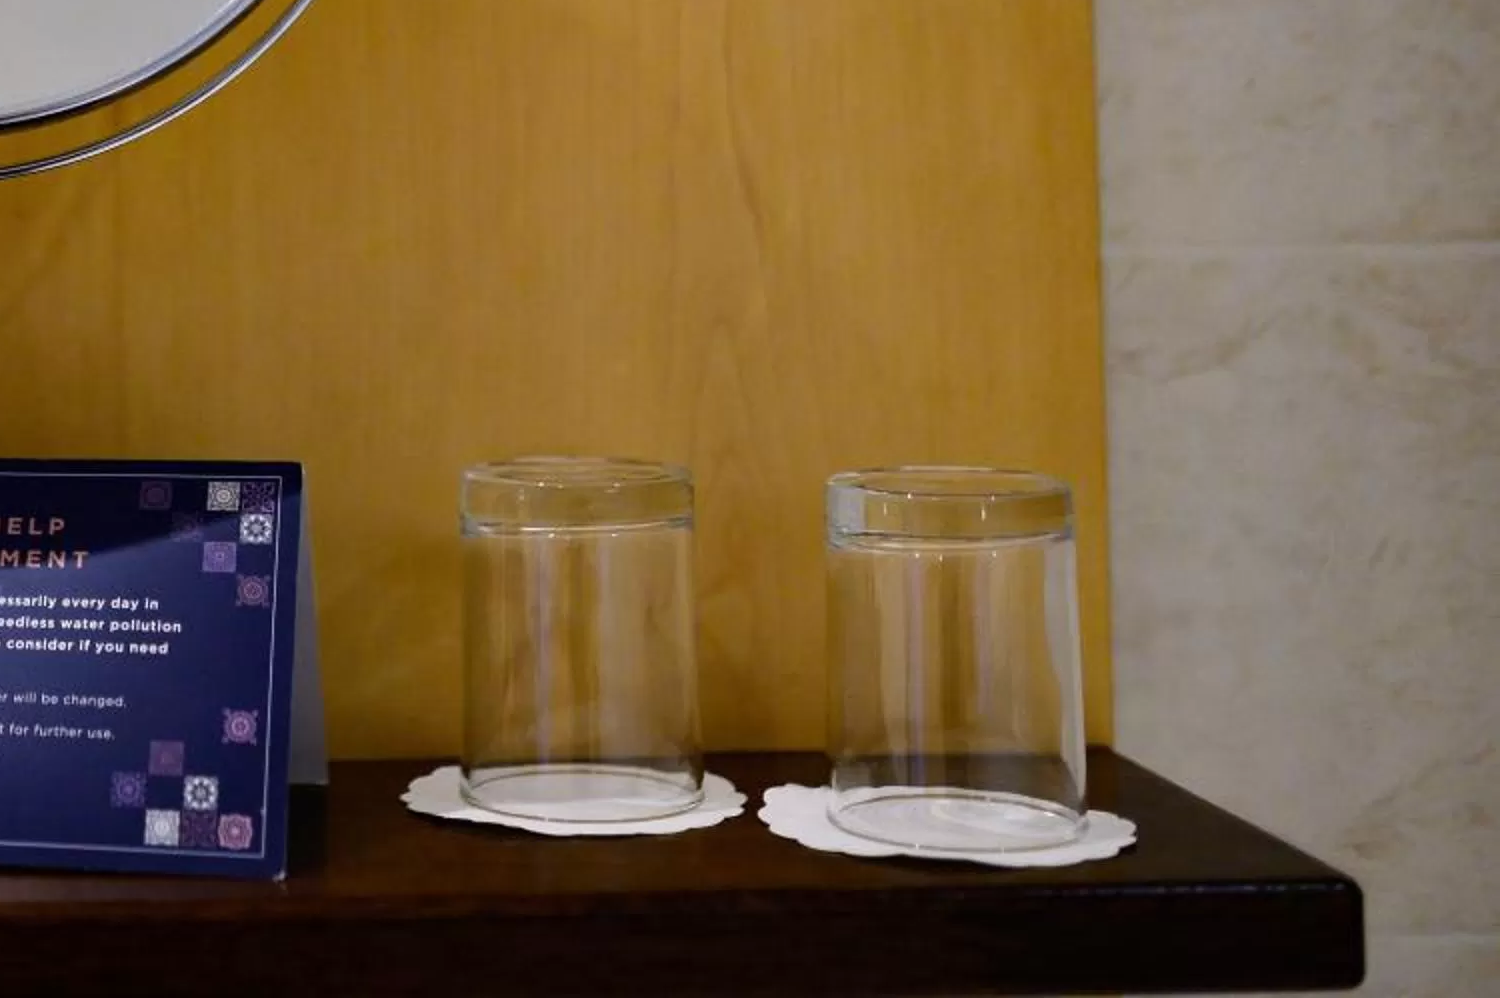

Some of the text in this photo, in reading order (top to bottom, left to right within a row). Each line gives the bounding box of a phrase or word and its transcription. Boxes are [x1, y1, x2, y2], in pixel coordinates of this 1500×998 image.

[62, 599, 104, 611] every
[111, 597, 139, 611] day
[145, 597, 159, 610] in
[60, 619, 104, 631] water
[109, 619, 181, 633] pollution
[6, 637, 74, 651] consider
[79, 639, 90, 651] if
[95, 642, 124, 654] you
[129, 642, 169, 655] need
[13, 692, 38, 704] will
[41, 694, 60, 705] be
[63, 695, 126, 709] changed.
[9, 724, 29, 736] for
[33, 724, 83, 738] further
[87, 730, 116, 740] use.
